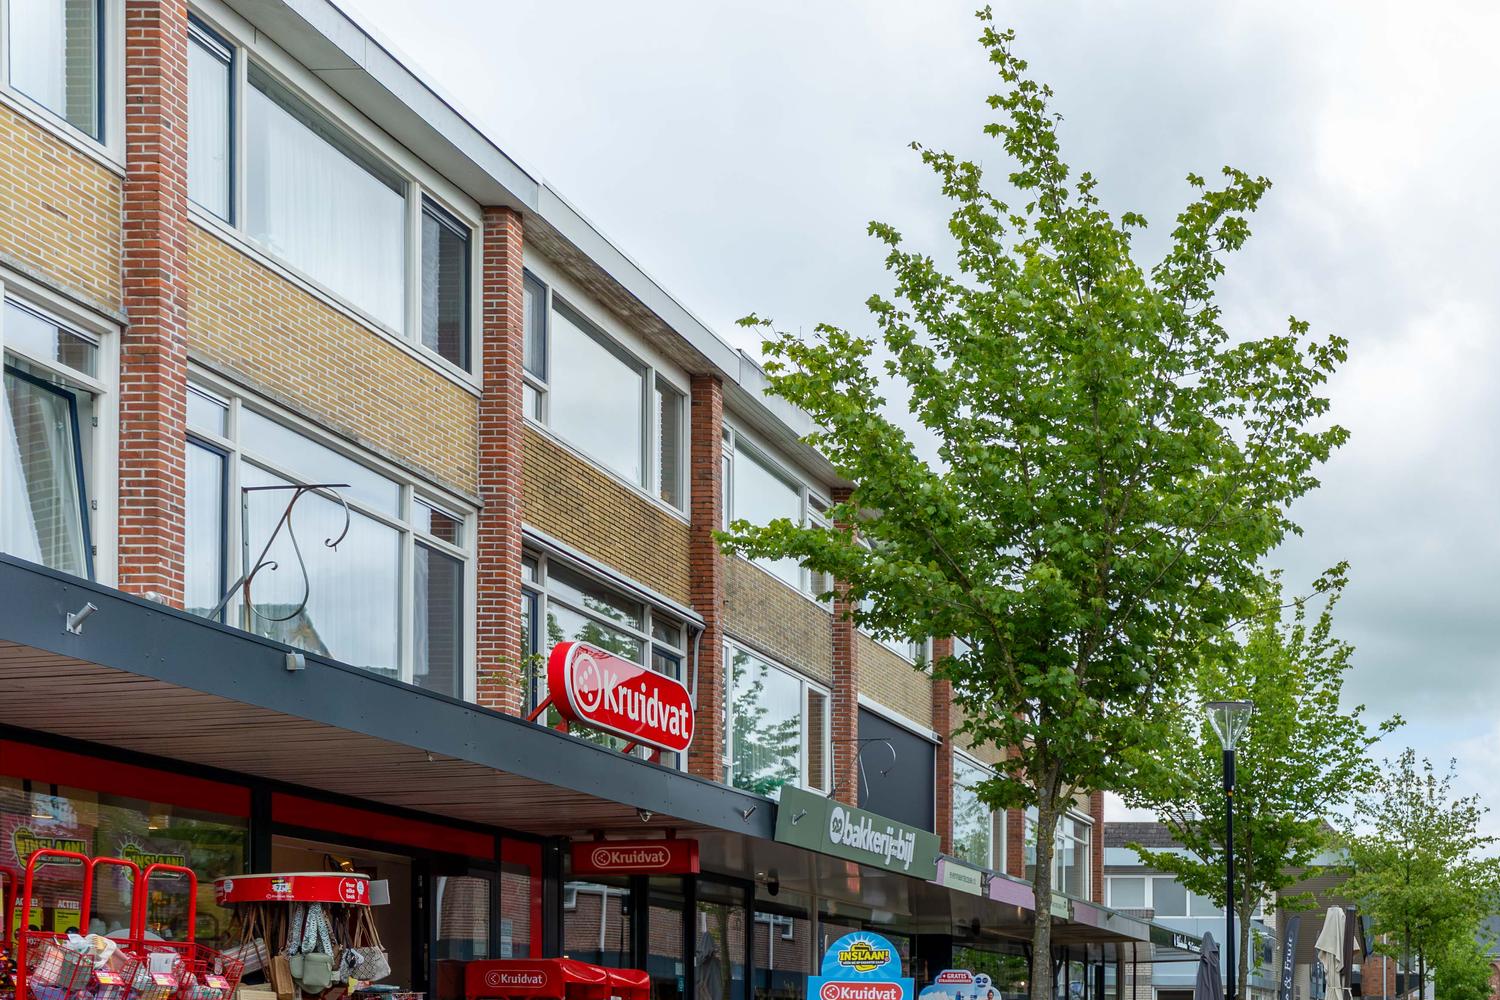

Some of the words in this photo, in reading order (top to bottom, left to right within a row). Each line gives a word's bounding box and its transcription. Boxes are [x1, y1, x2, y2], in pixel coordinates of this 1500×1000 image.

[604, 669, 689, 739] Kruidvat
[842, 811, 894, 865] bakkerij
[611, 850, 666, 863] Kruidvat
[839, 950, 889, 962] INSLAAN!
[500, 973, 543, 984] Kruidvat
[840, 986, 897, 1000] Kruidvat
